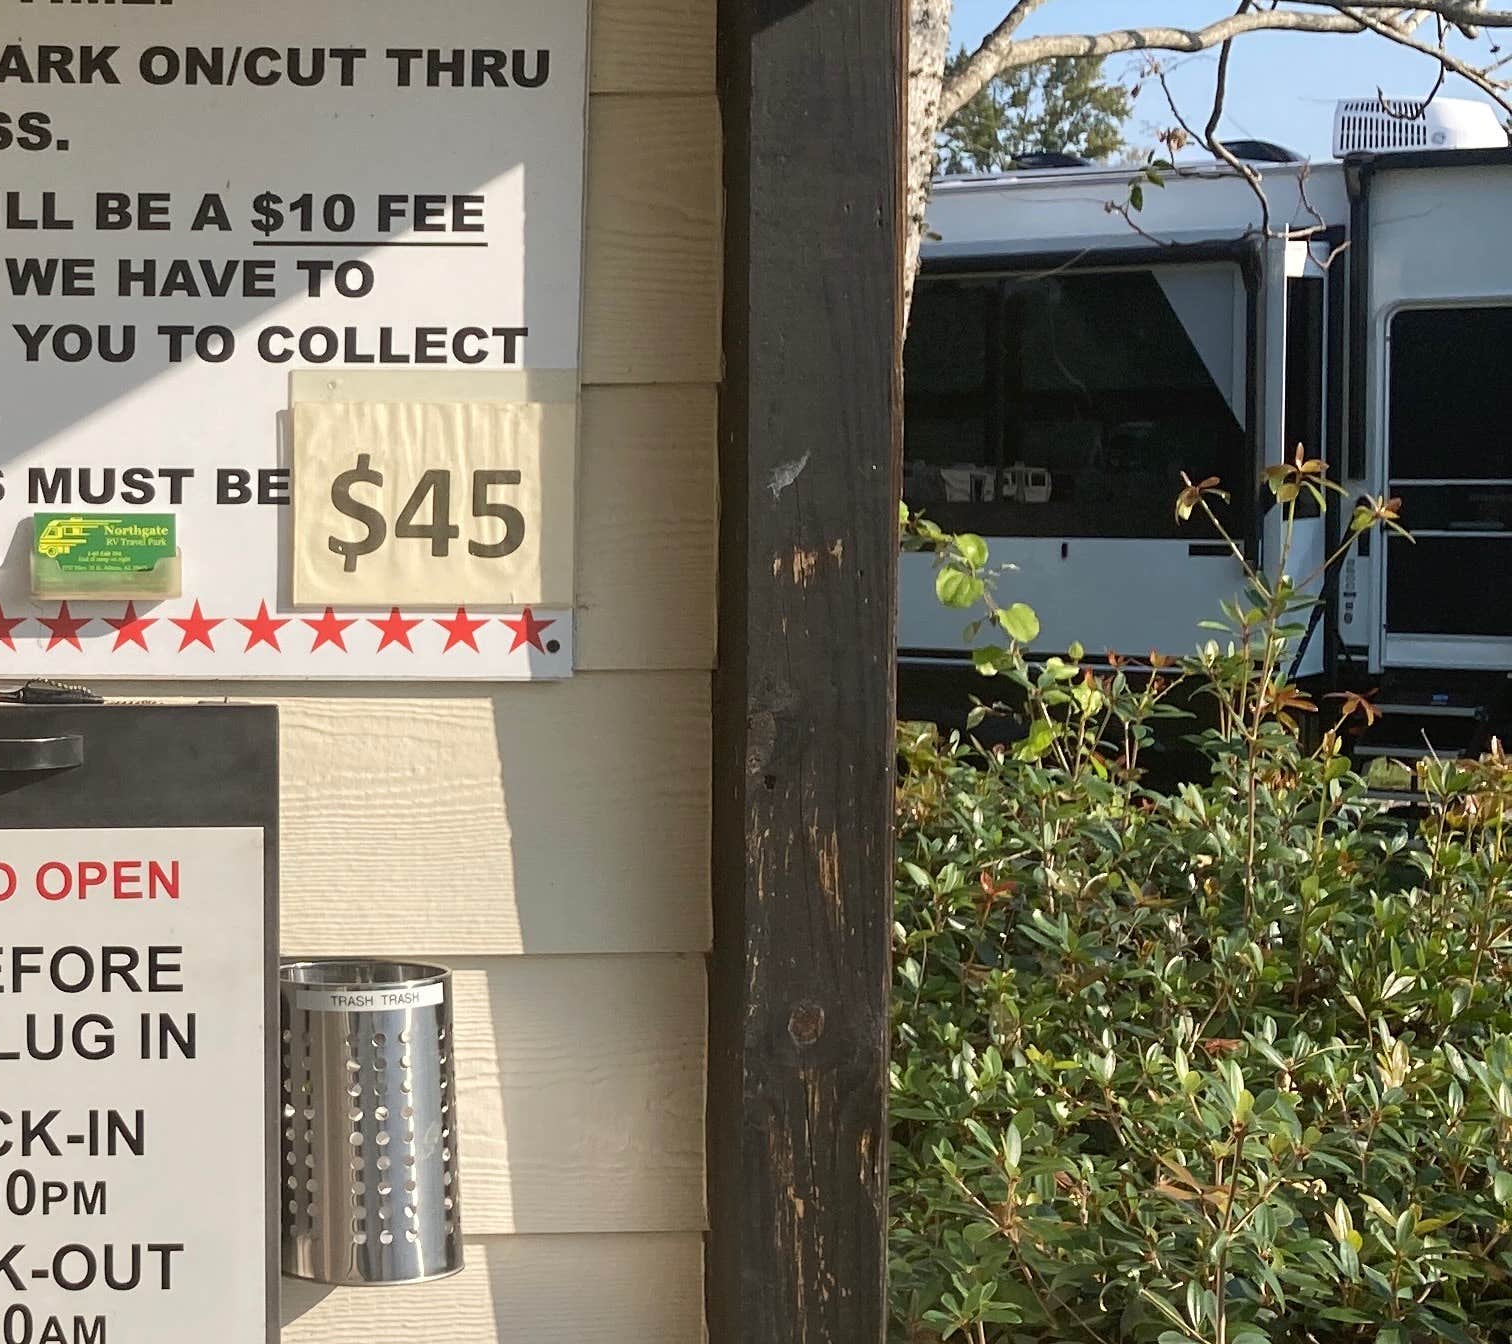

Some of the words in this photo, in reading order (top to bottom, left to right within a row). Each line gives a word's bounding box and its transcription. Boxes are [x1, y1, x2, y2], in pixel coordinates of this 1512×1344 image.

[140, 46, 366, 86] ON/CUT
[386, 49, 549, 87] THRU
[96, 193, 170, 230] BE
[191, 194, 232, 231] A
[251, 191, 354, 236] $10
[378, 195, 484, 232] FEE
[5, 258, 95, 296] WE
[119, 259, 275, 297] HAVE
[297, 260, 374, 297] TO
[13, 325, 135, 362] YOU
[158, 326, 234, 362] TO
[258, 326, 528, 363] COLLECT
[29, 468, 194, 504] MUST
[217, 469, 290, 505] BE
[105, 525, 168, 537] Northgate
[329, 454, 525, 573] $45
[122, 537, 146, 546] Travel
[148, 537, 167, 546] Park
[36, 861, 178, 900] OPEN
[331, 995, 373, 1006] TRASH
[381, 993, 420, 1003] TRASH
[141, 1013, 195, 1059] IN
